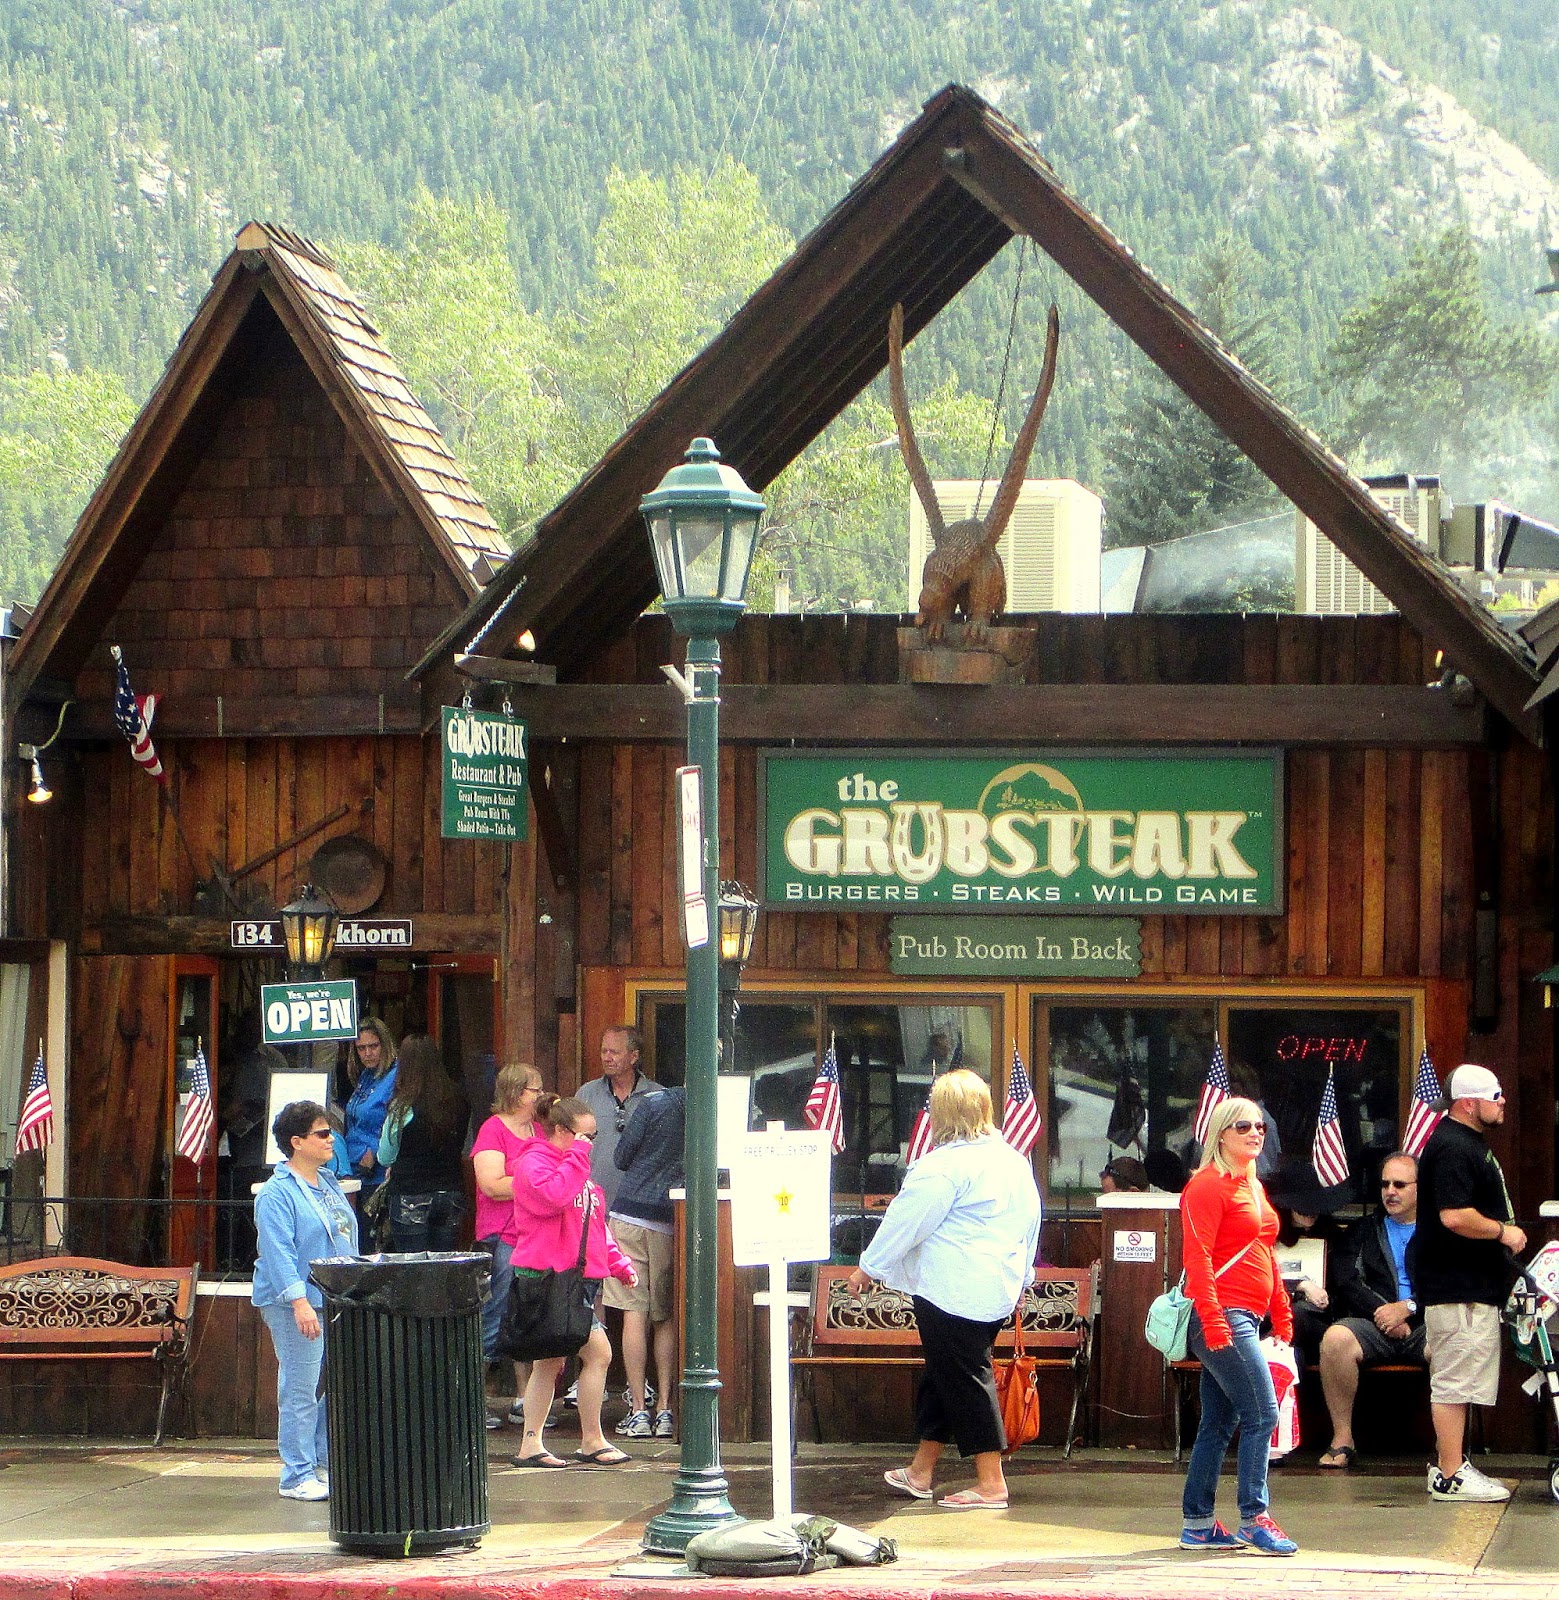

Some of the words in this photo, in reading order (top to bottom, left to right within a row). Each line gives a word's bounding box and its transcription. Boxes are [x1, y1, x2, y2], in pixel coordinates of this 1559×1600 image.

[447, 715, 526, 759] GRUBSTEAK
[451, 759, 497, 784] Restaurant
[499, 764, 505, 785] &
[506, 765, 522, 786] Pub
[458, 790, 473, 802] Great
[474, 791, 493, 807] Burgers
[837, 773, 899, 801] the
[463, 805, 474, 818] Pub
[474, 806, 488, 819] Room
[457, 820, 475, 833] Shaded
[506, 823, 516, 836] Out
[784, 801, 1259, 884] GRUBSTEAK
[786, 882, 920, 901] BURGERS
[951, 883, 1061, 901] STEAKS
[1092, 884, 1163, 902] WILD
[1176, 885, 1258, 903] GAME
[237, 923, 273, 944] 134
[335, 923, 407, 944] khorn
[898, 935, 948, 959] Pub
[954, 936, 1028, 960] Room
[1036, 936, 1063, 960] In
[1070, 936, 1133, 960] Back
[286, 990, 304, 1001] Yes,
[305, 989, 331, 999] we're
[267, 998, 352, 1034] OPEN
[1277, 1035, 1368, 1061] OPEN
